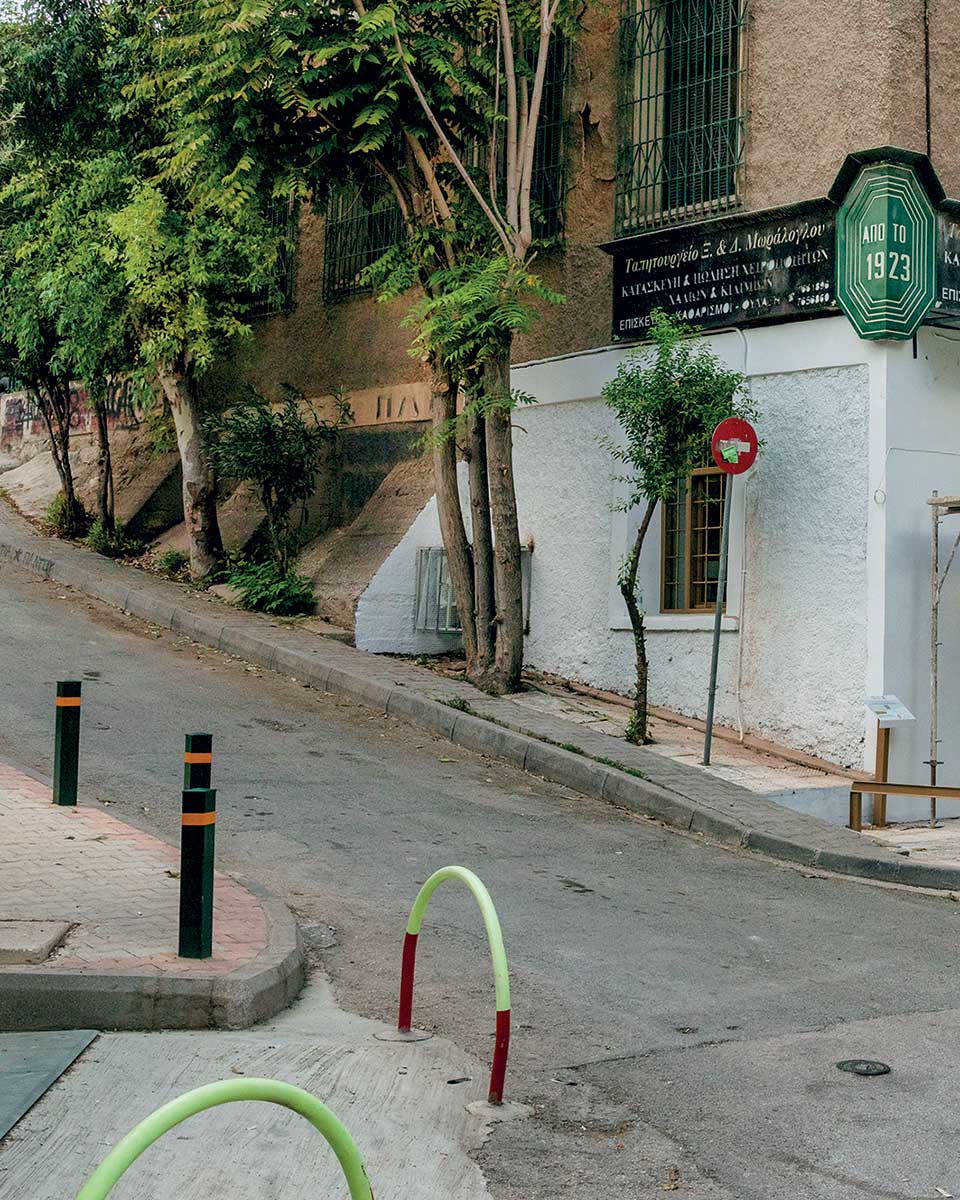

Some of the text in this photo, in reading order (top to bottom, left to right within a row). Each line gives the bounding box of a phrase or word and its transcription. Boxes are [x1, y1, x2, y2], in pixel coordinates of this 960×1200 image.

[862, 222, 906, 245] ΑΠΟ ΤΟ
[625, 244, 699, 273] Ταπητουργείο
[716, 239, 726, 256] &
[866, 251, 910, 283] 1923
[683, 273, 691, 287] &
[710, 286, 718, 299] &
